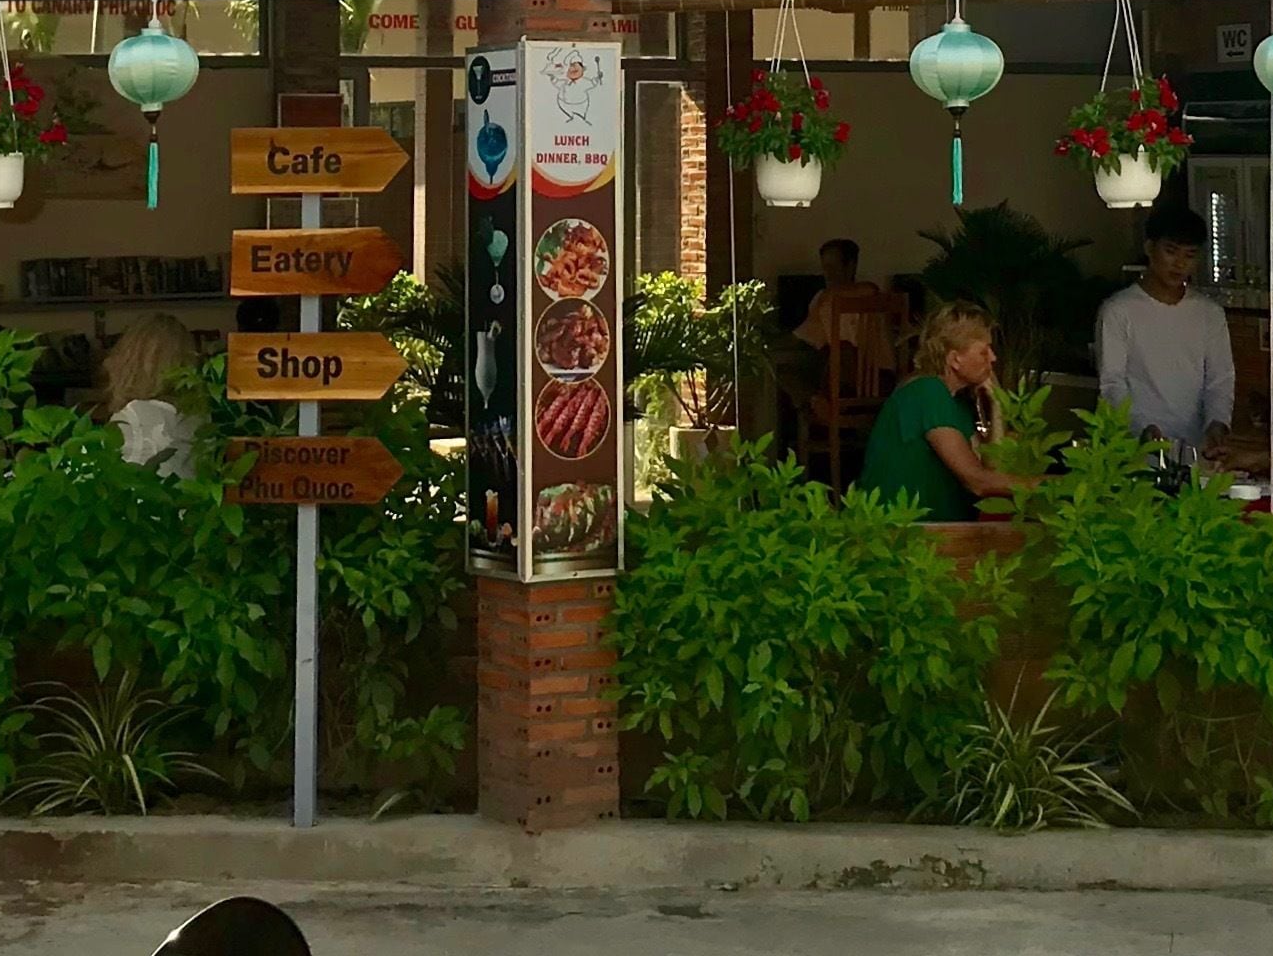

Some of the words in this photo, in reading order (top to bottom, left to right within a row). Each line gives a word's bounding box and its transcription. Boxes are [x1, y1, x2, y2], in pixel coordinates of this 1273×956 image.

[368, 14, 420, 30] COME
[1222, 29, 1248, 48] WC
[554, 135, 590, 147] LUNCH
[267, 145, 342, 175] Cafe
[584, 153, 608, 165] BBQ
[250, 244, 354, 277] Eatery
[256, 347, 343, 386] Shop
[238, 475, 284, 499] Phu
[292, 474, 355, 500] Quoc
